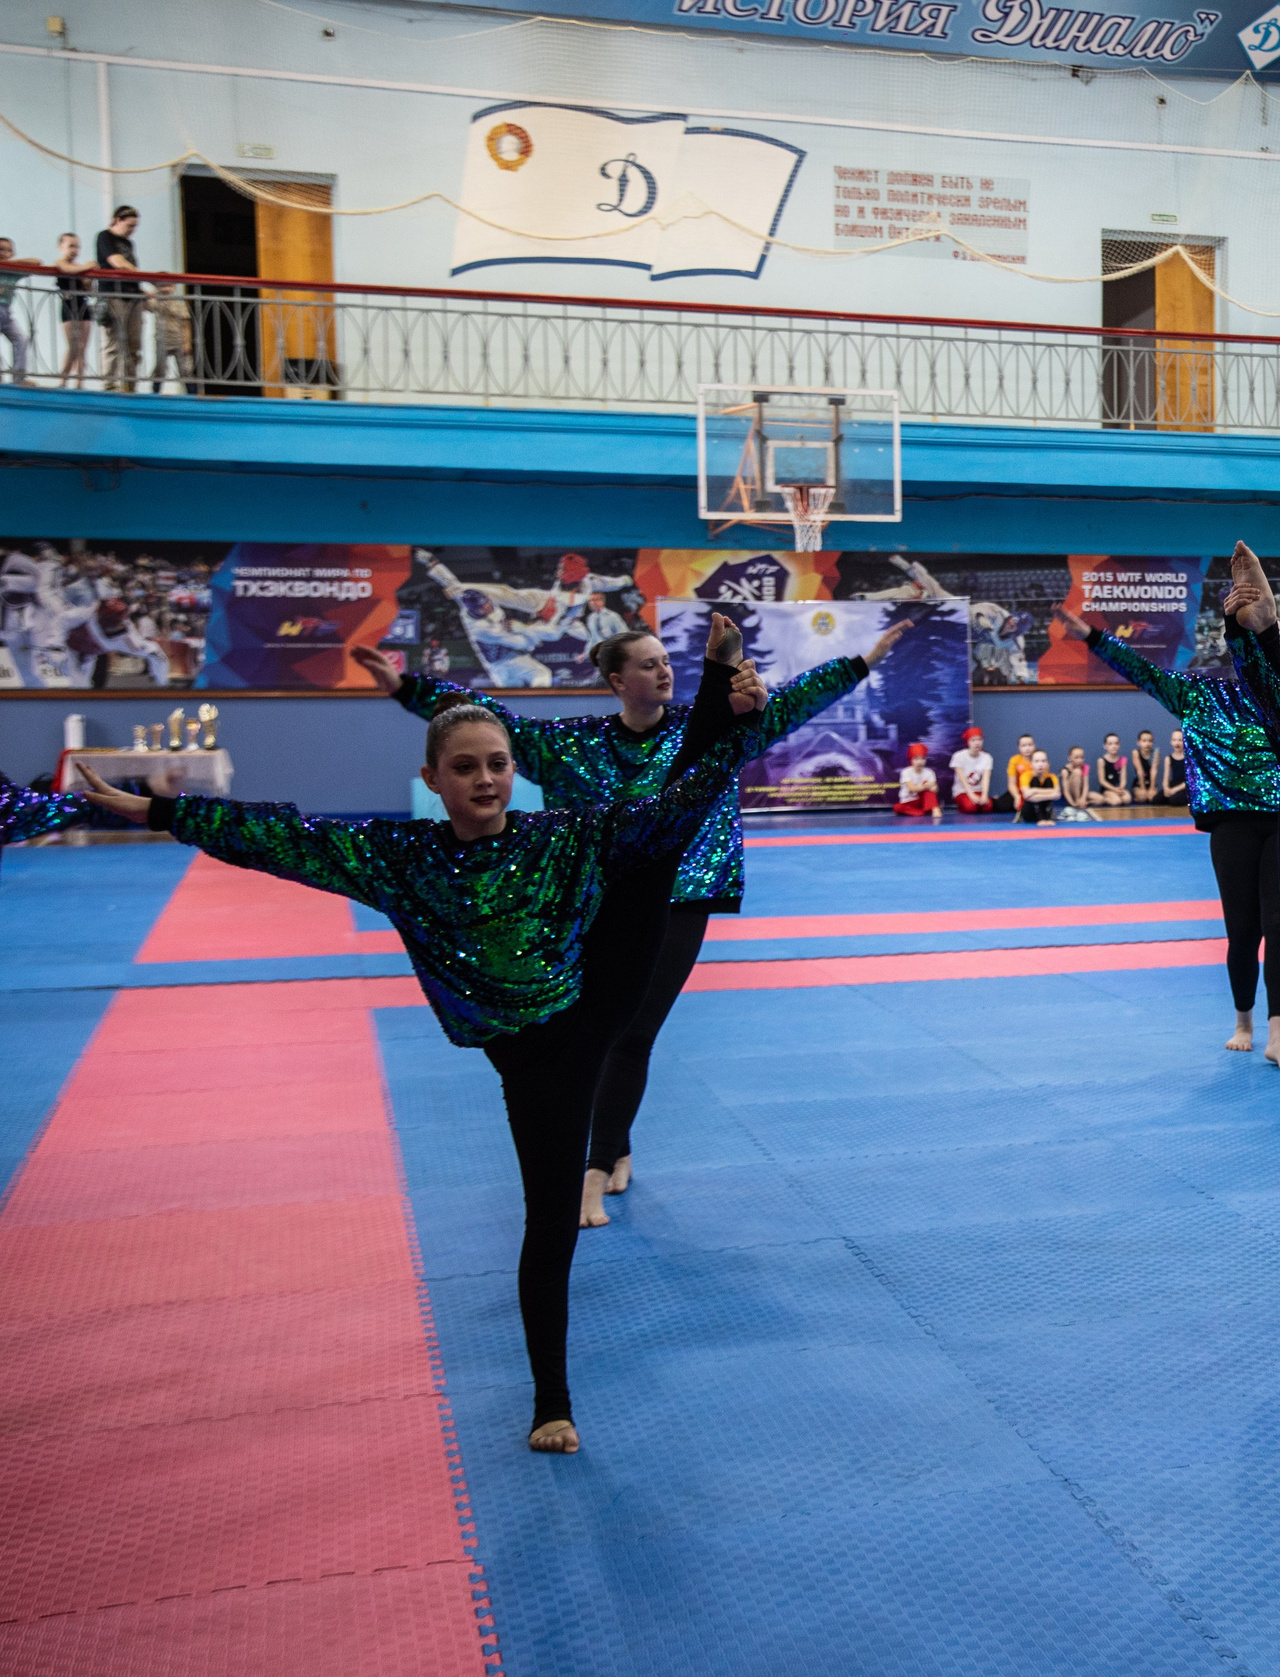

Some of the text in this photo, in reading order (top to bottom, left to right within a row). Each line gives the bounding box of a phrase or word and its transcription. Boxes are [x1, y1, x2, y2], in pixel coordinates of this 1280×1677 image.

[1082, 571, 1188, 583] 2015 WTF WORLD
[232, 580, 373, 601] ТХЭКВОНДО
[1082, 584, 1188, 599] TAEKWONDO
[1082, 601, 1188, 612] CHAMPIONSHIPS
